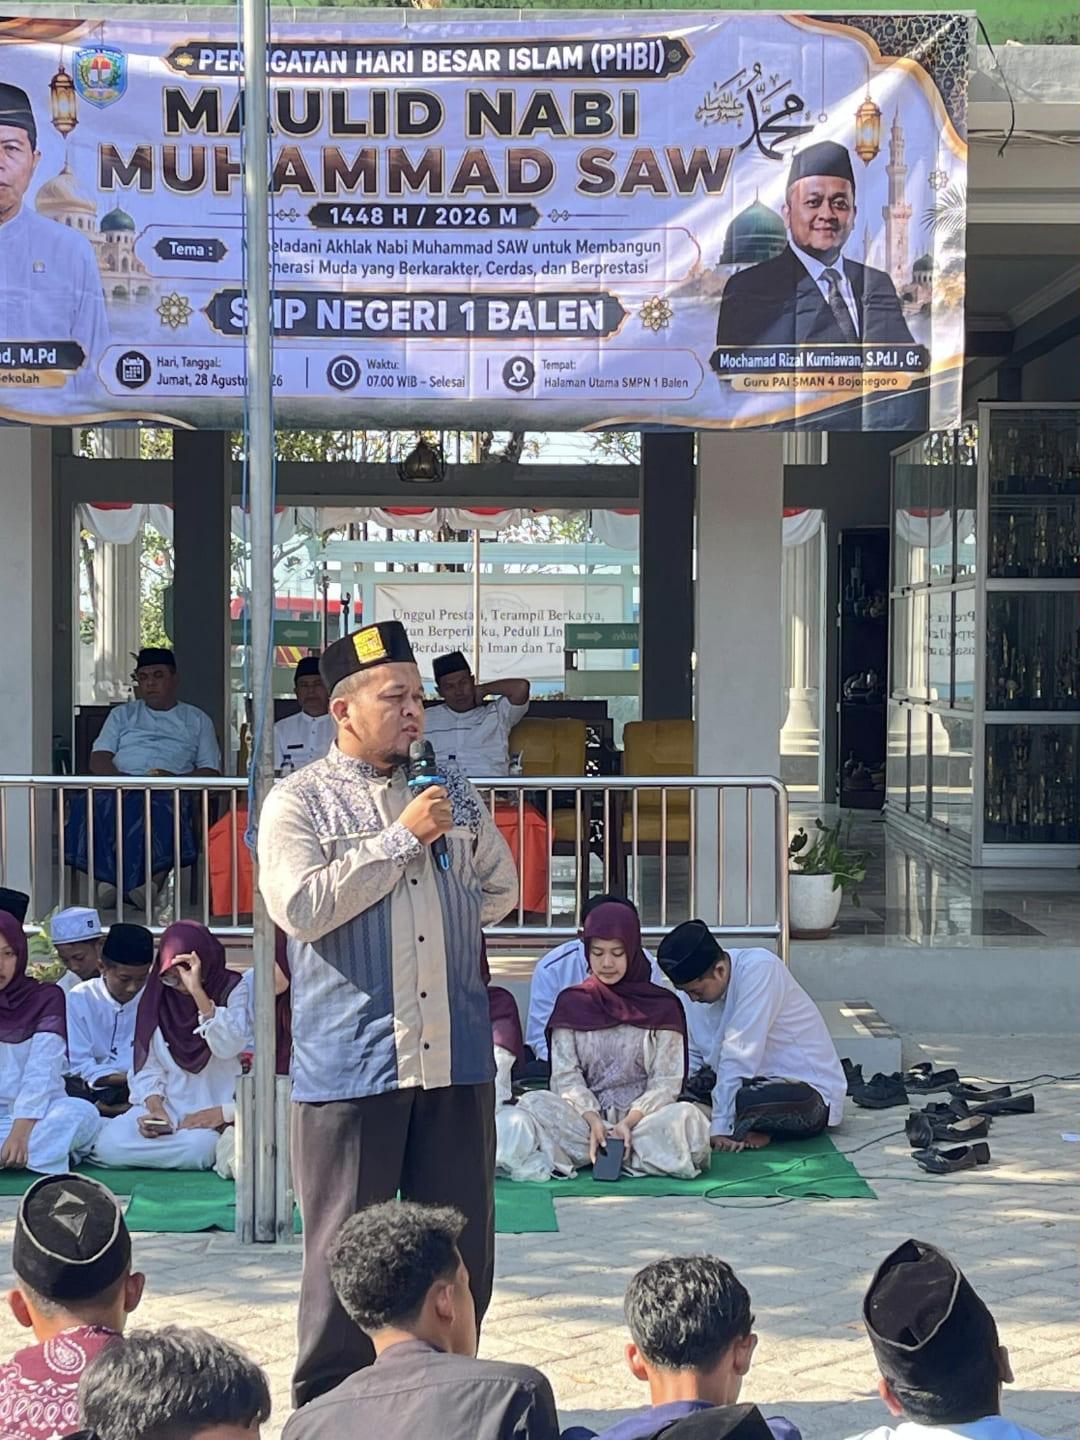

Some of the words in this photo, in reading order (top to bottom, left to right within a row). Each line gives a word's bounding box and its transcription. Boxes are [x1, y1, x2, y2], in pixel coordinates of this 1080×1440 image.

[199, 49, 348, 74] PERGATAN
[356, 50, 414, 74] HARI
[423, 48, 500, 73] BESAR
[508, 46, 583, 72] ISLAM
[590, 42, 666, 74] (PHBI)
[465, 89, 639, 138] NABI
[575, 147, 736, 197] SAW
[329, 207, 384, 225] 1448
[392, 207, 408, 225] H
[416, 206, 424, 226] /
[435, 206, 490, 225] 2026
[499, 207, 517, 225] M
[169, 242, 203, 257] Tema
[326, 239, 372, 254] Akhlak
[376, 239, 408, 254] Nabi
[412, 239, 494, 255] Muhammad
[497, 240, 528, 254] SAW
[532, 240, 573, 254] untuk
[576, 239, 661, 258] Membangun
[319, 261, 357, 275] Muda
[361, 262, 395, 278] yang
[399, 260, 484, 278] Berkarakter,
[486, 261, 537, 278] Cerdas,
[541, 261, 567, 275] dan
[571, 260, 648, 278] Berprestasi
[316, 299, 446, 331] NEGERI
[459, 303, 473, 331] 1
[488, 299, 604, 332] BALEN
[21, 347, 57, 364] M.Pd
[720, 353, 776, 368] Mochamad
[778, 352, 804, 367] Rizal
[806, 353, 864, 369] Kurniawan,
[157, 356, 180, 369] Hari,
[182, 356, 221, 370] Tanggal:
[366, 359, 399, 370] Waktu:
[542, 359, 576, 372] Tempat:
[0, 372, 40, 385] ekolah
[157, 374, 192, 387] Jumat,
[195, 374, 208, 385] 28
[211, 374, 248, 388] Agustu
[366, 376, 394, 388] 07.00
[396, 376, 418, 388] WIB
[429, 376, 465, 388] Selesai
[544, 377, 586, 388] Halaman
[589, 377, 619, 388] Utama
[622, 377, 650, 388] SMPN
[662, 377, 689, 388] Balen
[743, 377, 770, 388] Guru
[772, 377, 790, 387] PAI
[793, 376, 825, 387] SMAN
[828, 377, 834, 386] 4
[838, 376, 898, 389] Bojonegoro
[392, 609, 436, 622] Unggul
[439, 609, 488, 622] Prestai,
[491, 609, 545, 622] Terampil
[549, 609, 605, 623] Berkarya,
[428, 626, 499, 640] Berperilku,
[503, 626, 540, 637] Peduli
[488, 642, 517, 653] Iman
[521, 642, 543, 653] dan
